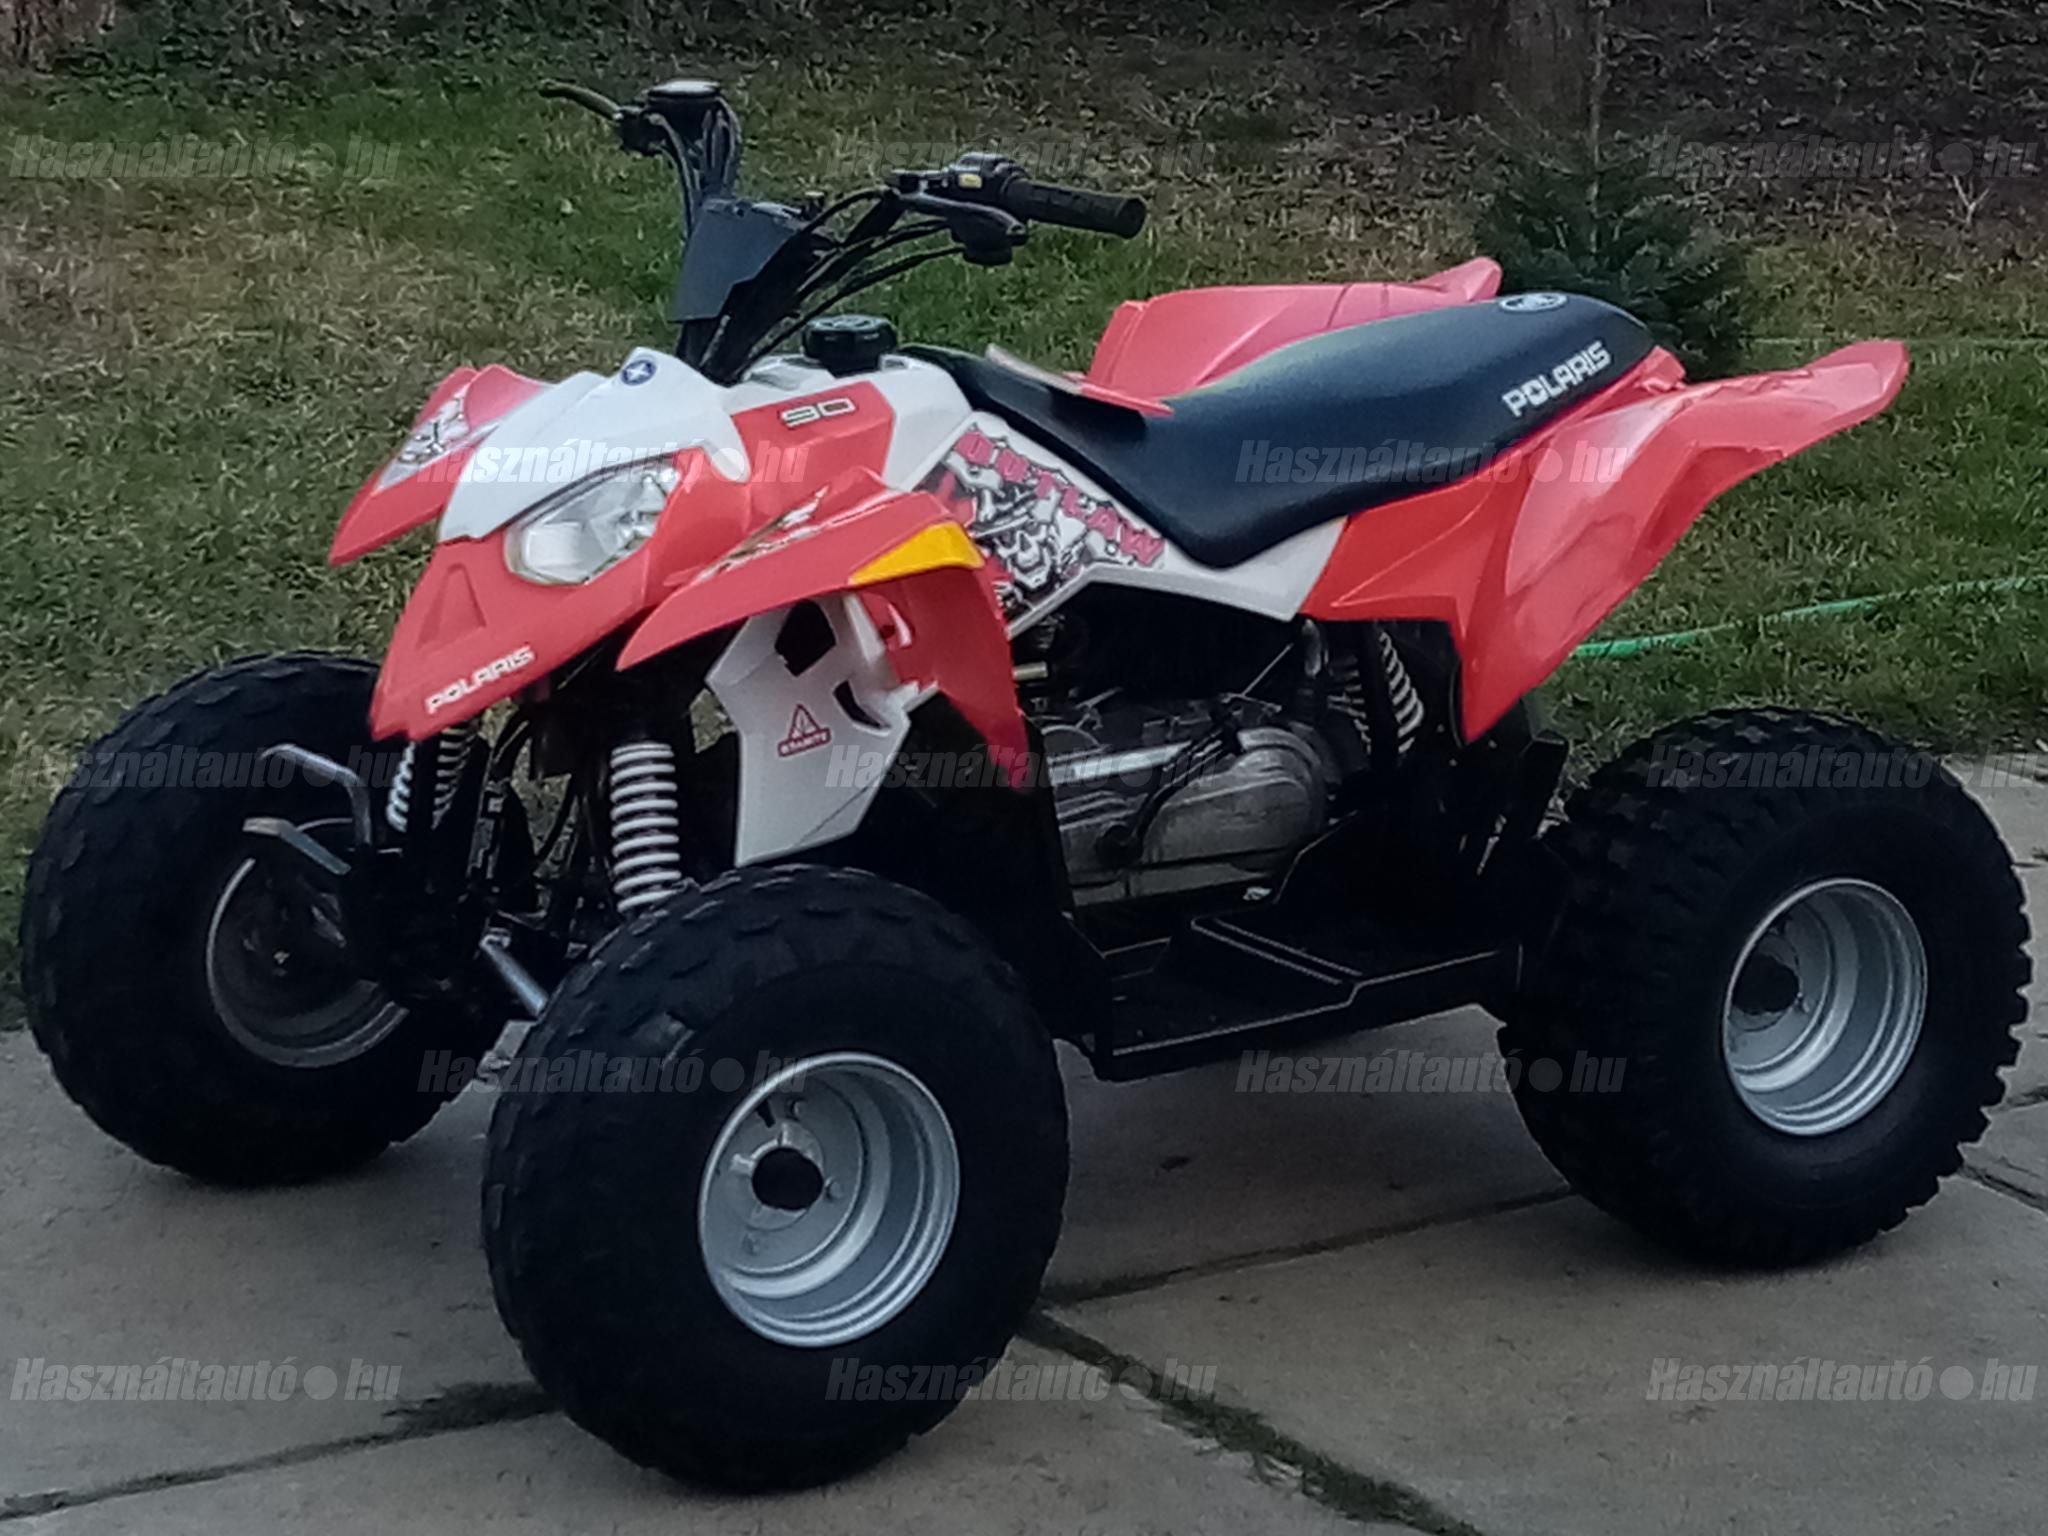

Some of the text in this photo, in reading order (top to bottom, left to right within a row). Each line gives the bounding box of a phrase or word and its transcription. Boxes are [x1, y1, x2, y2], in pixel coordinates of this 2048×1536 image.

[780, 397, 857, 429] 90
[1502, 340, 1612, 417] POLARIS
[424, 644, 535, 715] POLARIS
